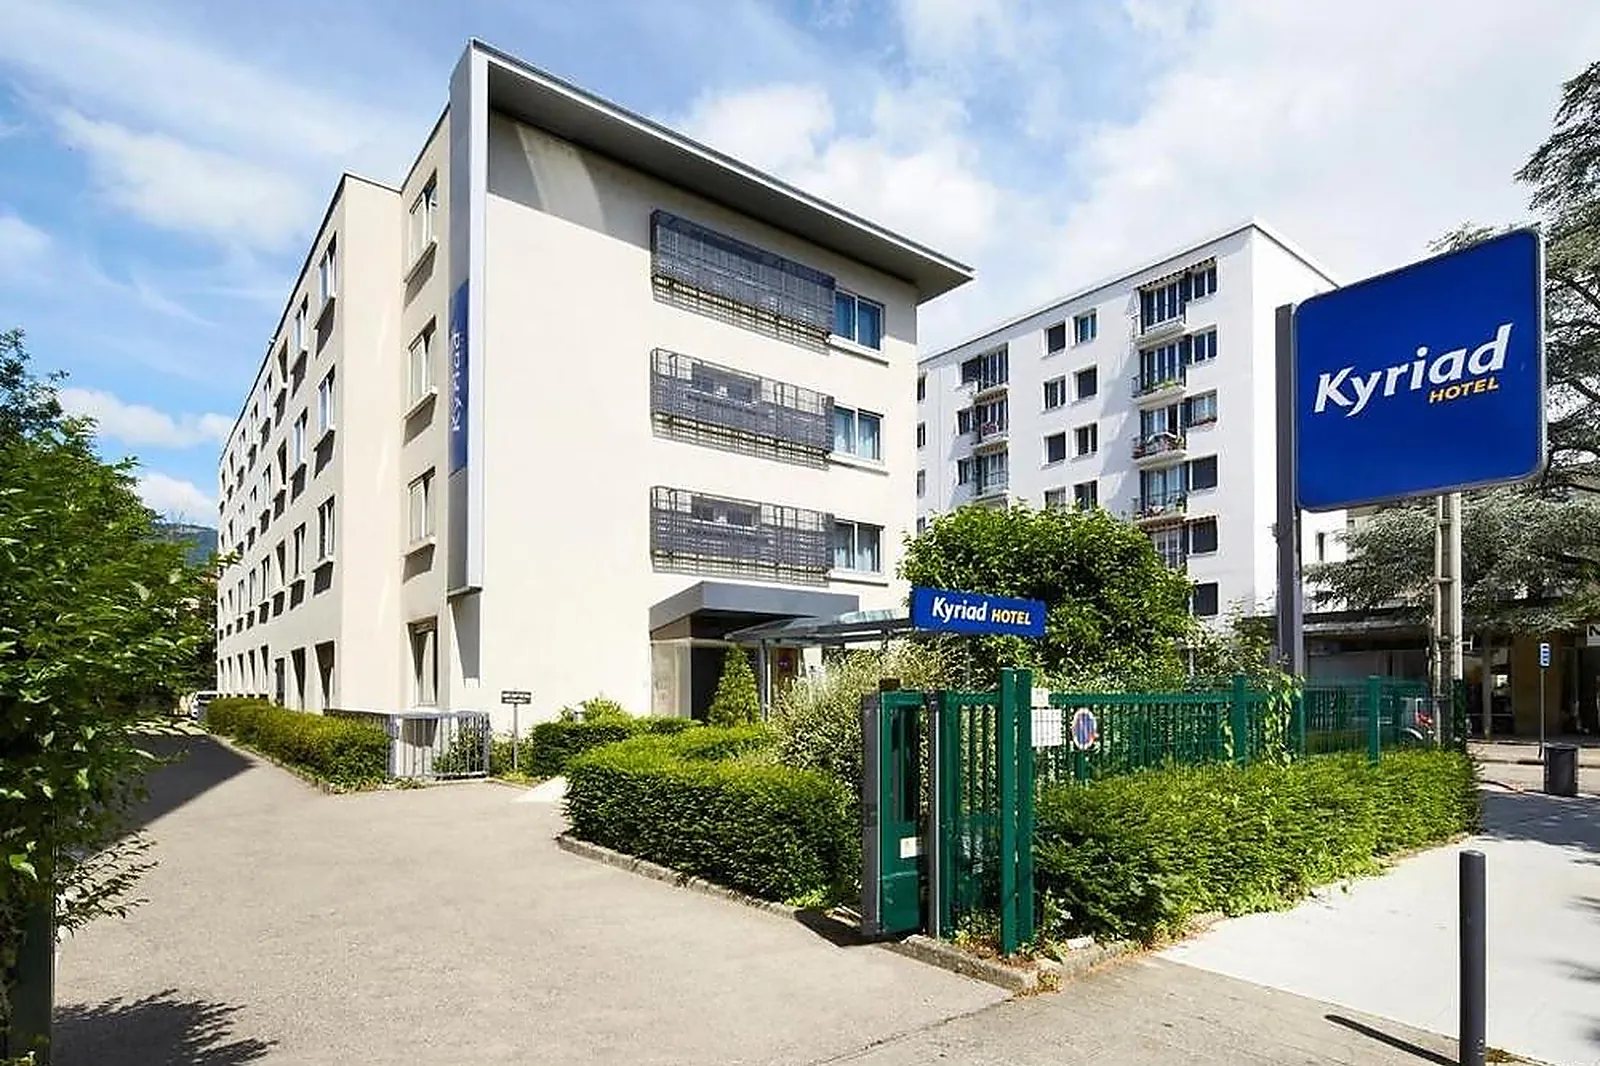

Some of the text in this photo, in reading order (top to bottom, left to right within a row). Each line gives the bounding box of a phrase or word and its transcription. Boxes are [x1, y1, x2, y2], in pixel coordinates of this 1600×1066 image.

[451, 331, 462, 432] Kyriad
[1314, 322, 1513, 417] Kyriad
[1429, 376, 1499, 403] HOTEL
[932, 596, 1031, 625] Kyriad HOTEL
